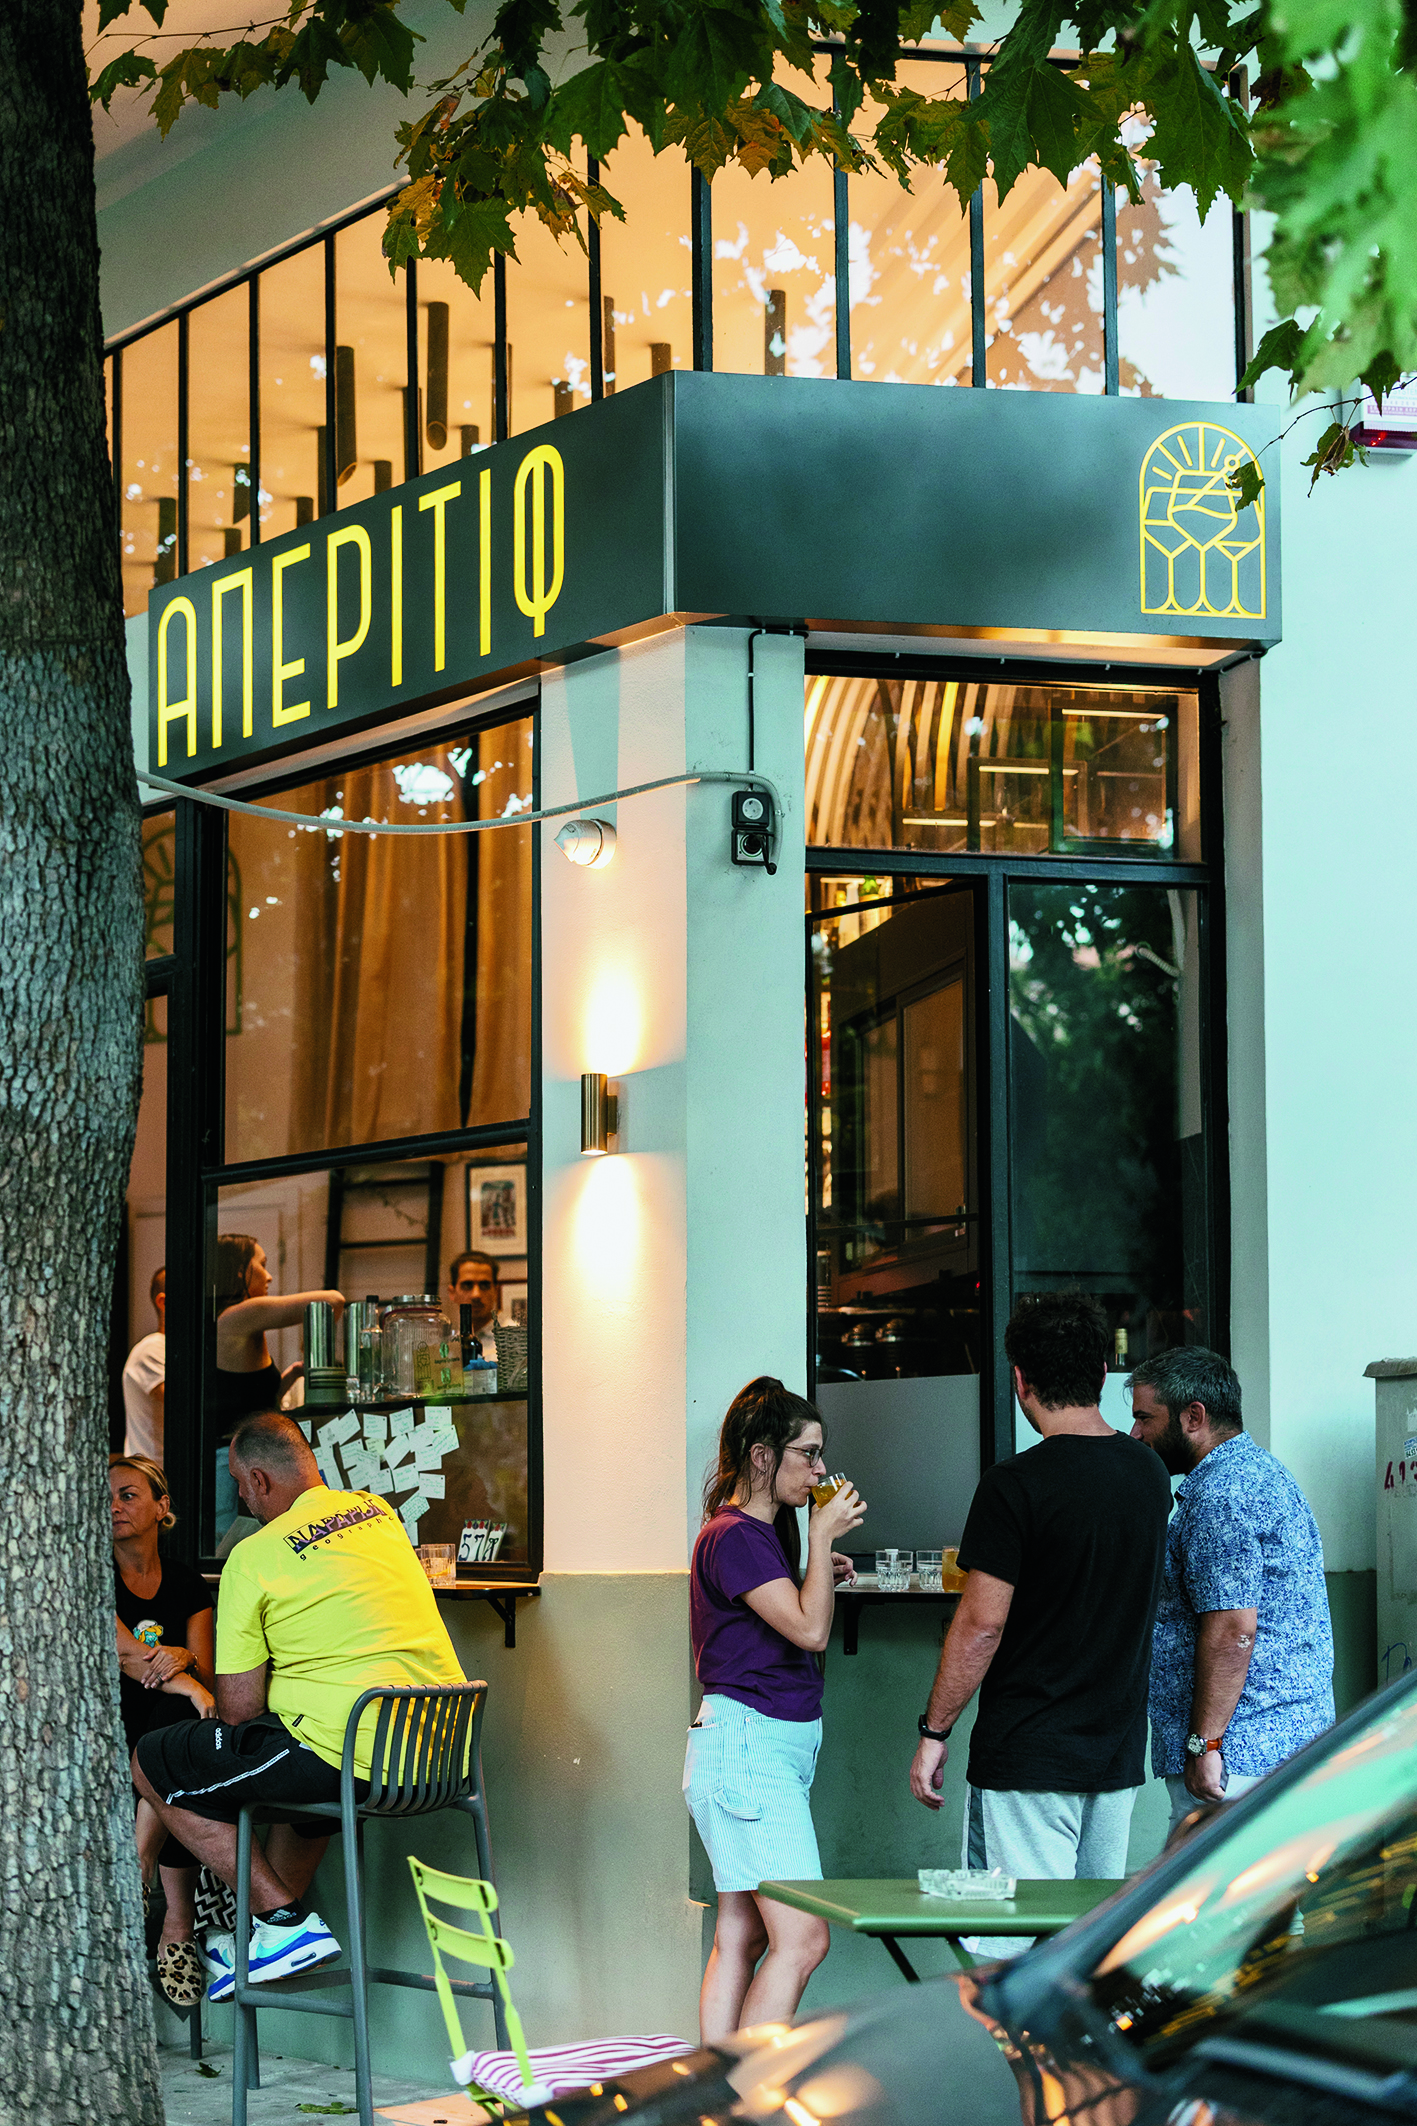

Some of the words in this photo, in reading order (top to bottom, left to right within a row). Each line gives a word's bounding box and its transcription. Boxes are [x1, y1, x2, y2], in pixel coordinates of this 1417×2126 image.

[158, 444, 565, 767] ΑΠΕΡΙΤΙΦ
[287, 1498, 388, 1551] NAPAPIJ
[214, 1727, 223, 1751] adidas
